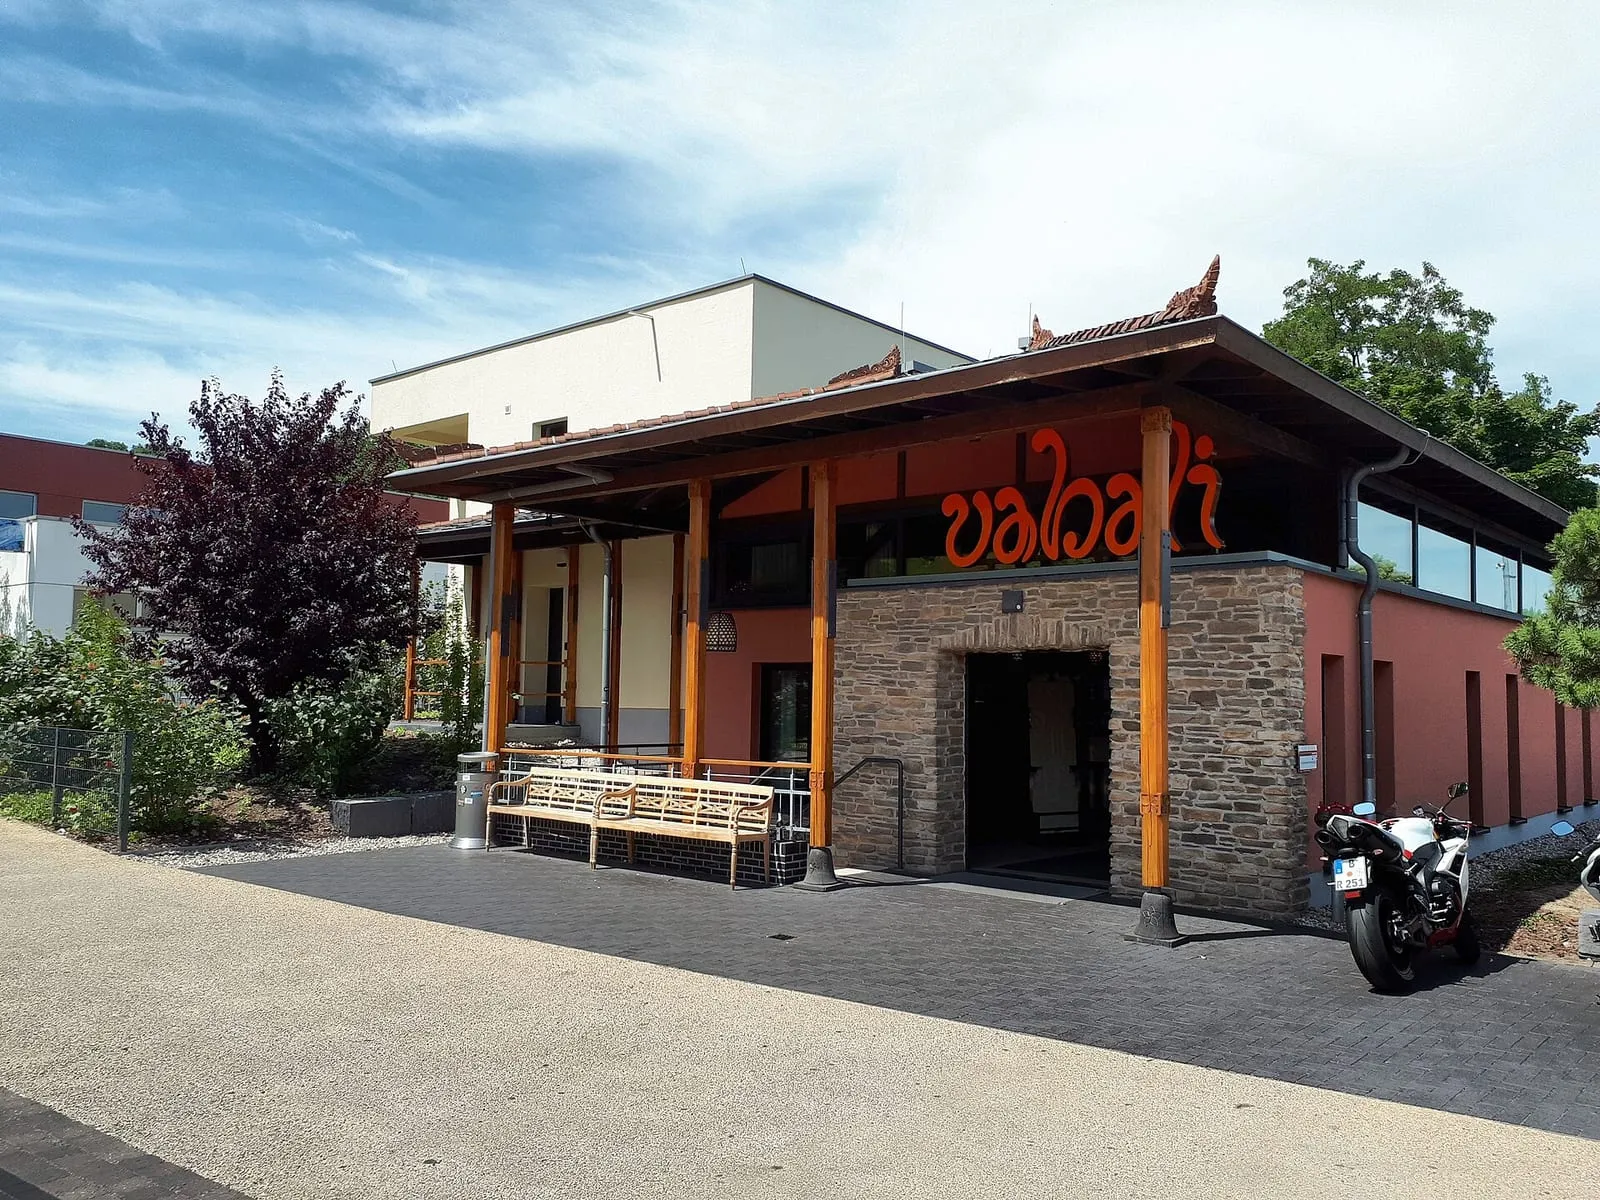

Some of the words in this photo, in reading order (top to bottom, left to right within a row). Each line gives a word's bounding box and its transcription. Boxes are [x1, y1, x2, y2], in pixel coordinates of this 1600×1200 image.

[941, 420, 1226, 567] vabali
[1348, 859, 1355, 868] B
[1336, 880, 1343, 889] R
[1345, 878, 1365, 888] 251
